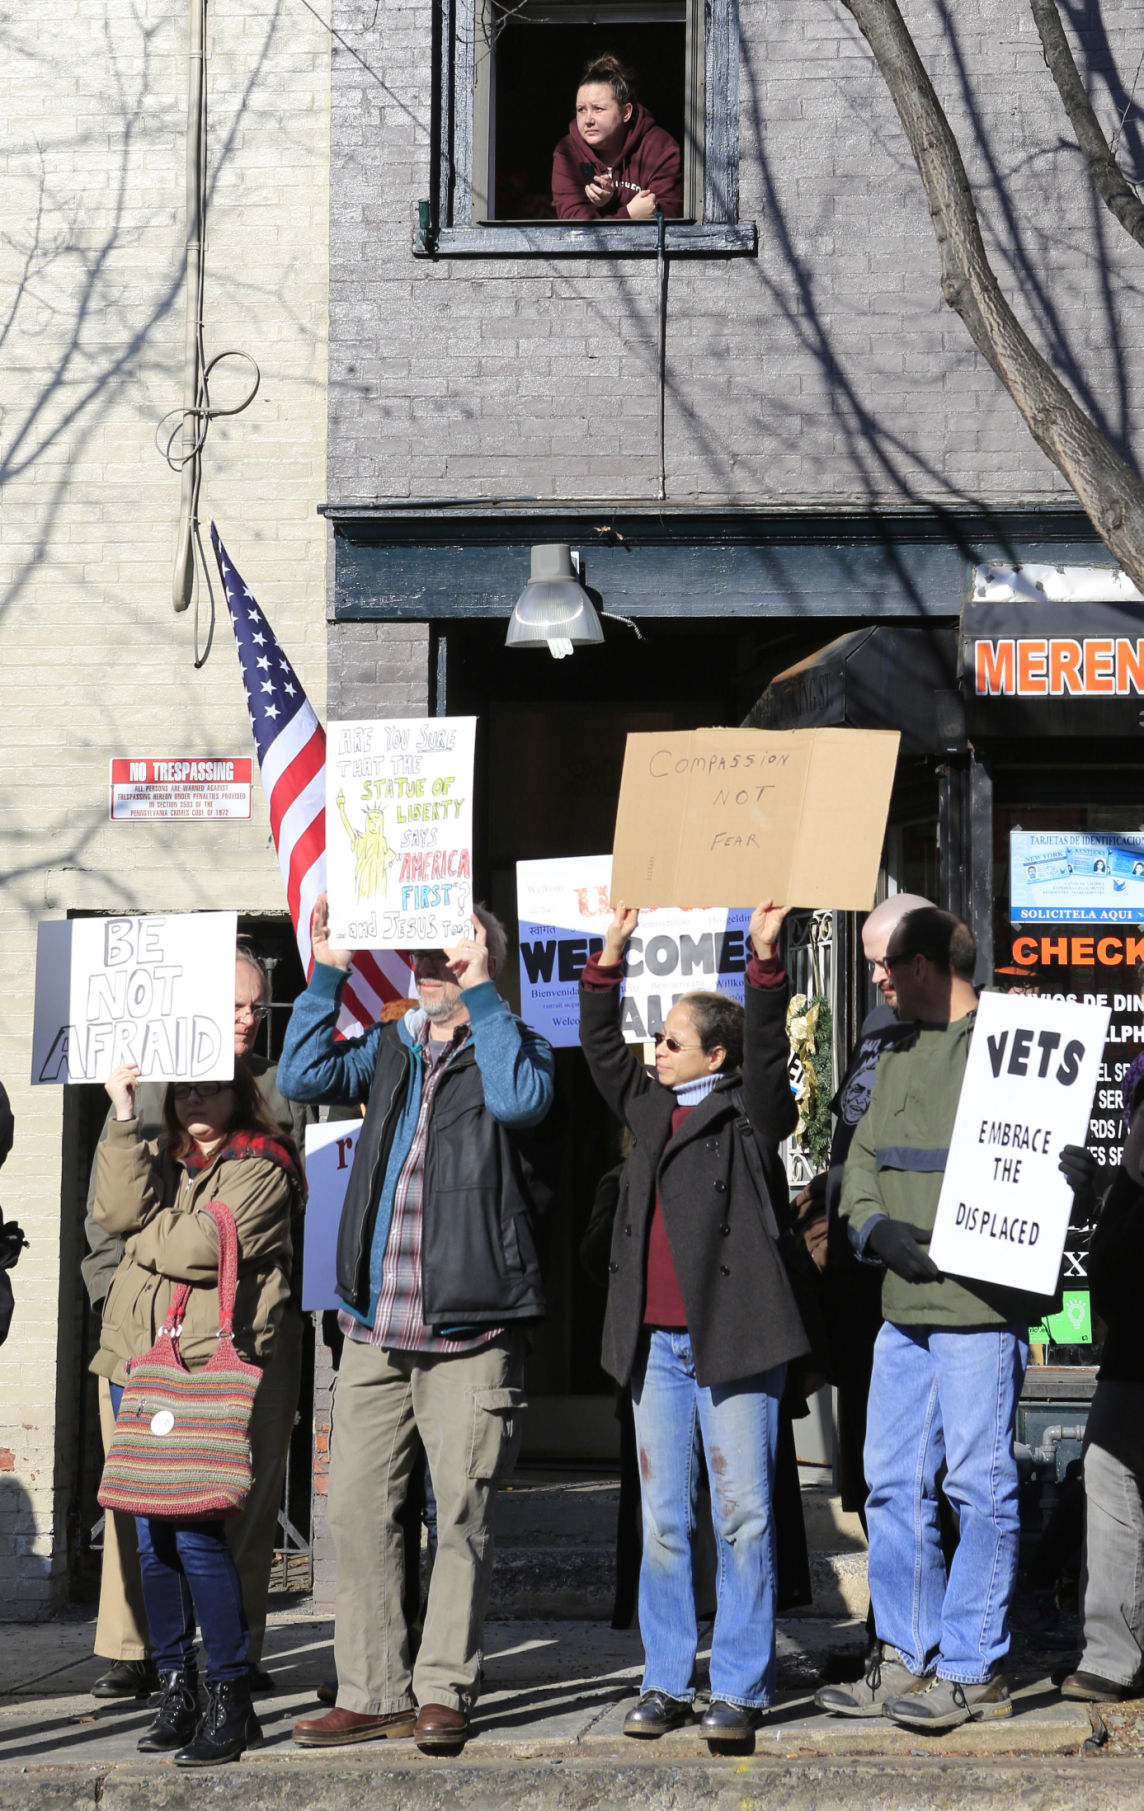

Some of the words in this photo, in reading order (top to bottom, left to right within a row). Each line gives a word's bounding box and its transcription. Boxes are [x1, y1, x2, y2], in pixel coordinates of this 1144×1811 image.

[975, 638, 1144, 696] MEREN
[339, 726, 374, 755] ARE
[384, 725, 411, 751] YOU
[416, 723, 457, 752] SURE
[129, 762, 147, 782] NO
[152, 762, 235, 782] TRESPASSING
[336, 755, 385, 778] THAT
[390, 755, 423, 775] THE
[361, 777, 427, 801] STATUE
[432, 776, 456, 796] OF
[713, 785, 776, 806] NOT
[130, 809, 168, 817] PENNSYLVANIA
[170, 809, 190, 817] CRIMES
[192, 809, 204, 817] CODE
[396, 798, 466, 823] LIBERTY
[400, 828, 438, 848] SAYS
[710, 832, 761, 851] FEAR
[1030, 836, 1069, 845] TARJETAS
[1070, 836, 1080, 845] DE
[1020, 909, 1097, 919] SOLICITELA
[1100, 910, 1132, 920] AQUI
[104, 917, 166, 967] BE
[86, 964, 183, 1022] NOT
[39, 1014, 222, 1082] AFRAID
[987, 1028, 1086, 1087] VETS
[978, 1120, 1052, 1155] EMBRACE
[993, 1157, 1022, 1183] THE
[955, 1202, 1040, 1246] DISPLACED
